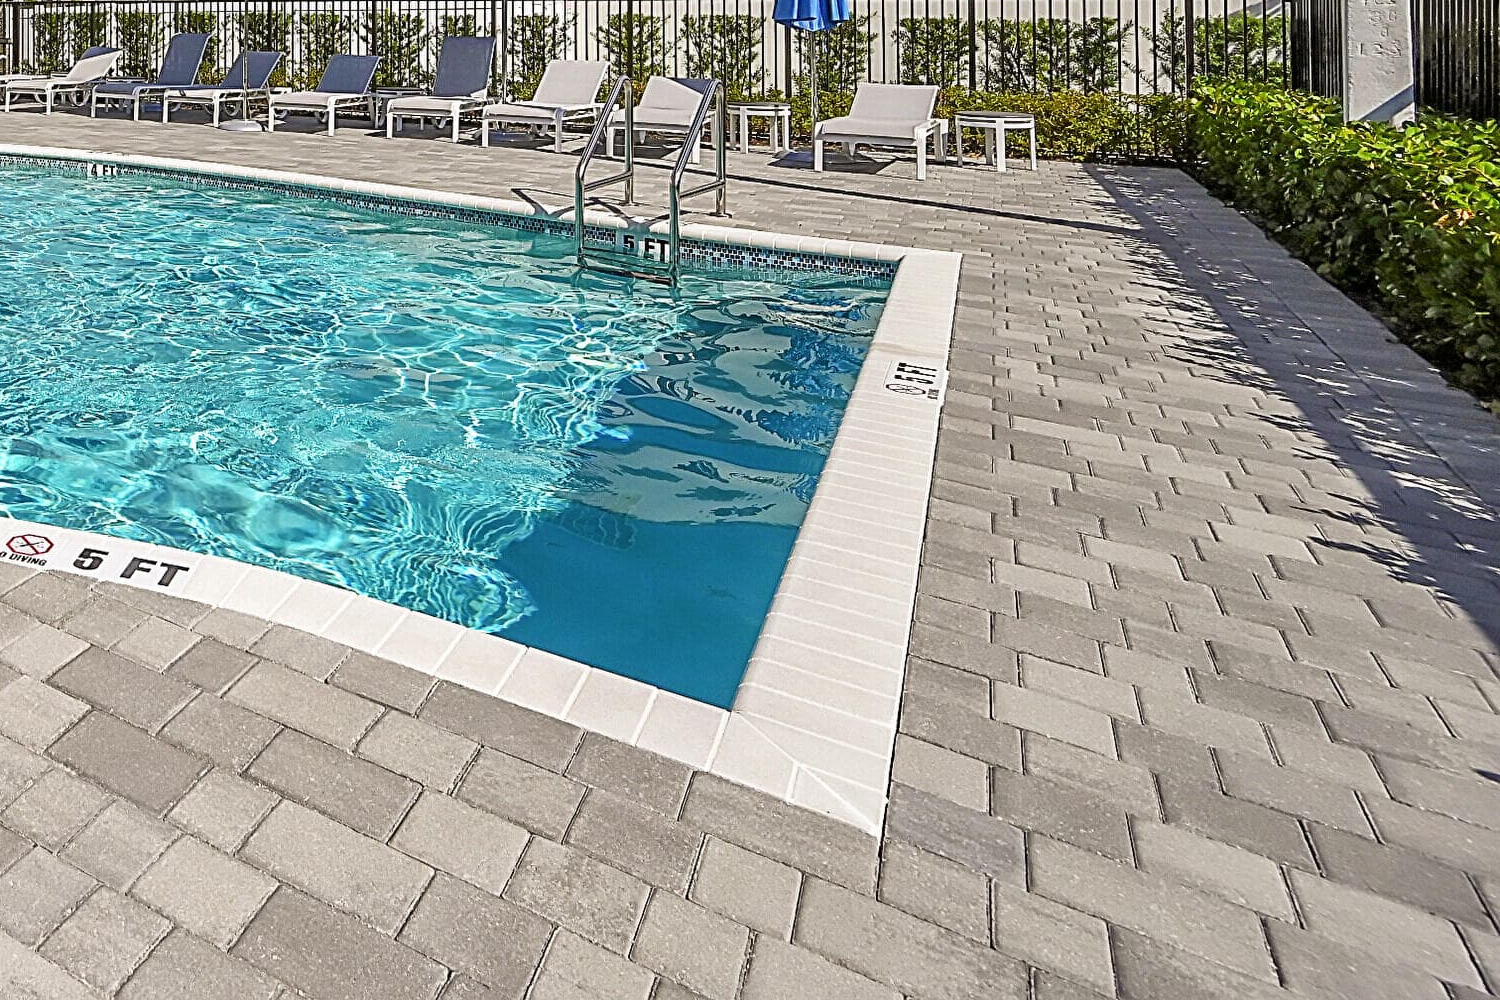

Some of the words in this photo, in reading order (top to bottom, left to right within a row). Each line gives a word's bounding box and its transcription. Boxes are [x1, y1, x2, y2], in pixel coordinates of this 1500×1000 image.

[102, 164, 116, 177] FT
[623, 234, 635, 250] 5
[644, 238, 670, 263] FT
[896, 362, 938, 378] FT
[894, 374, 935, 385] 5
[8, 552, 48, 568] DIVING
[72, 547, 110, 572] 5
[119, 556, 190, 588] FT
